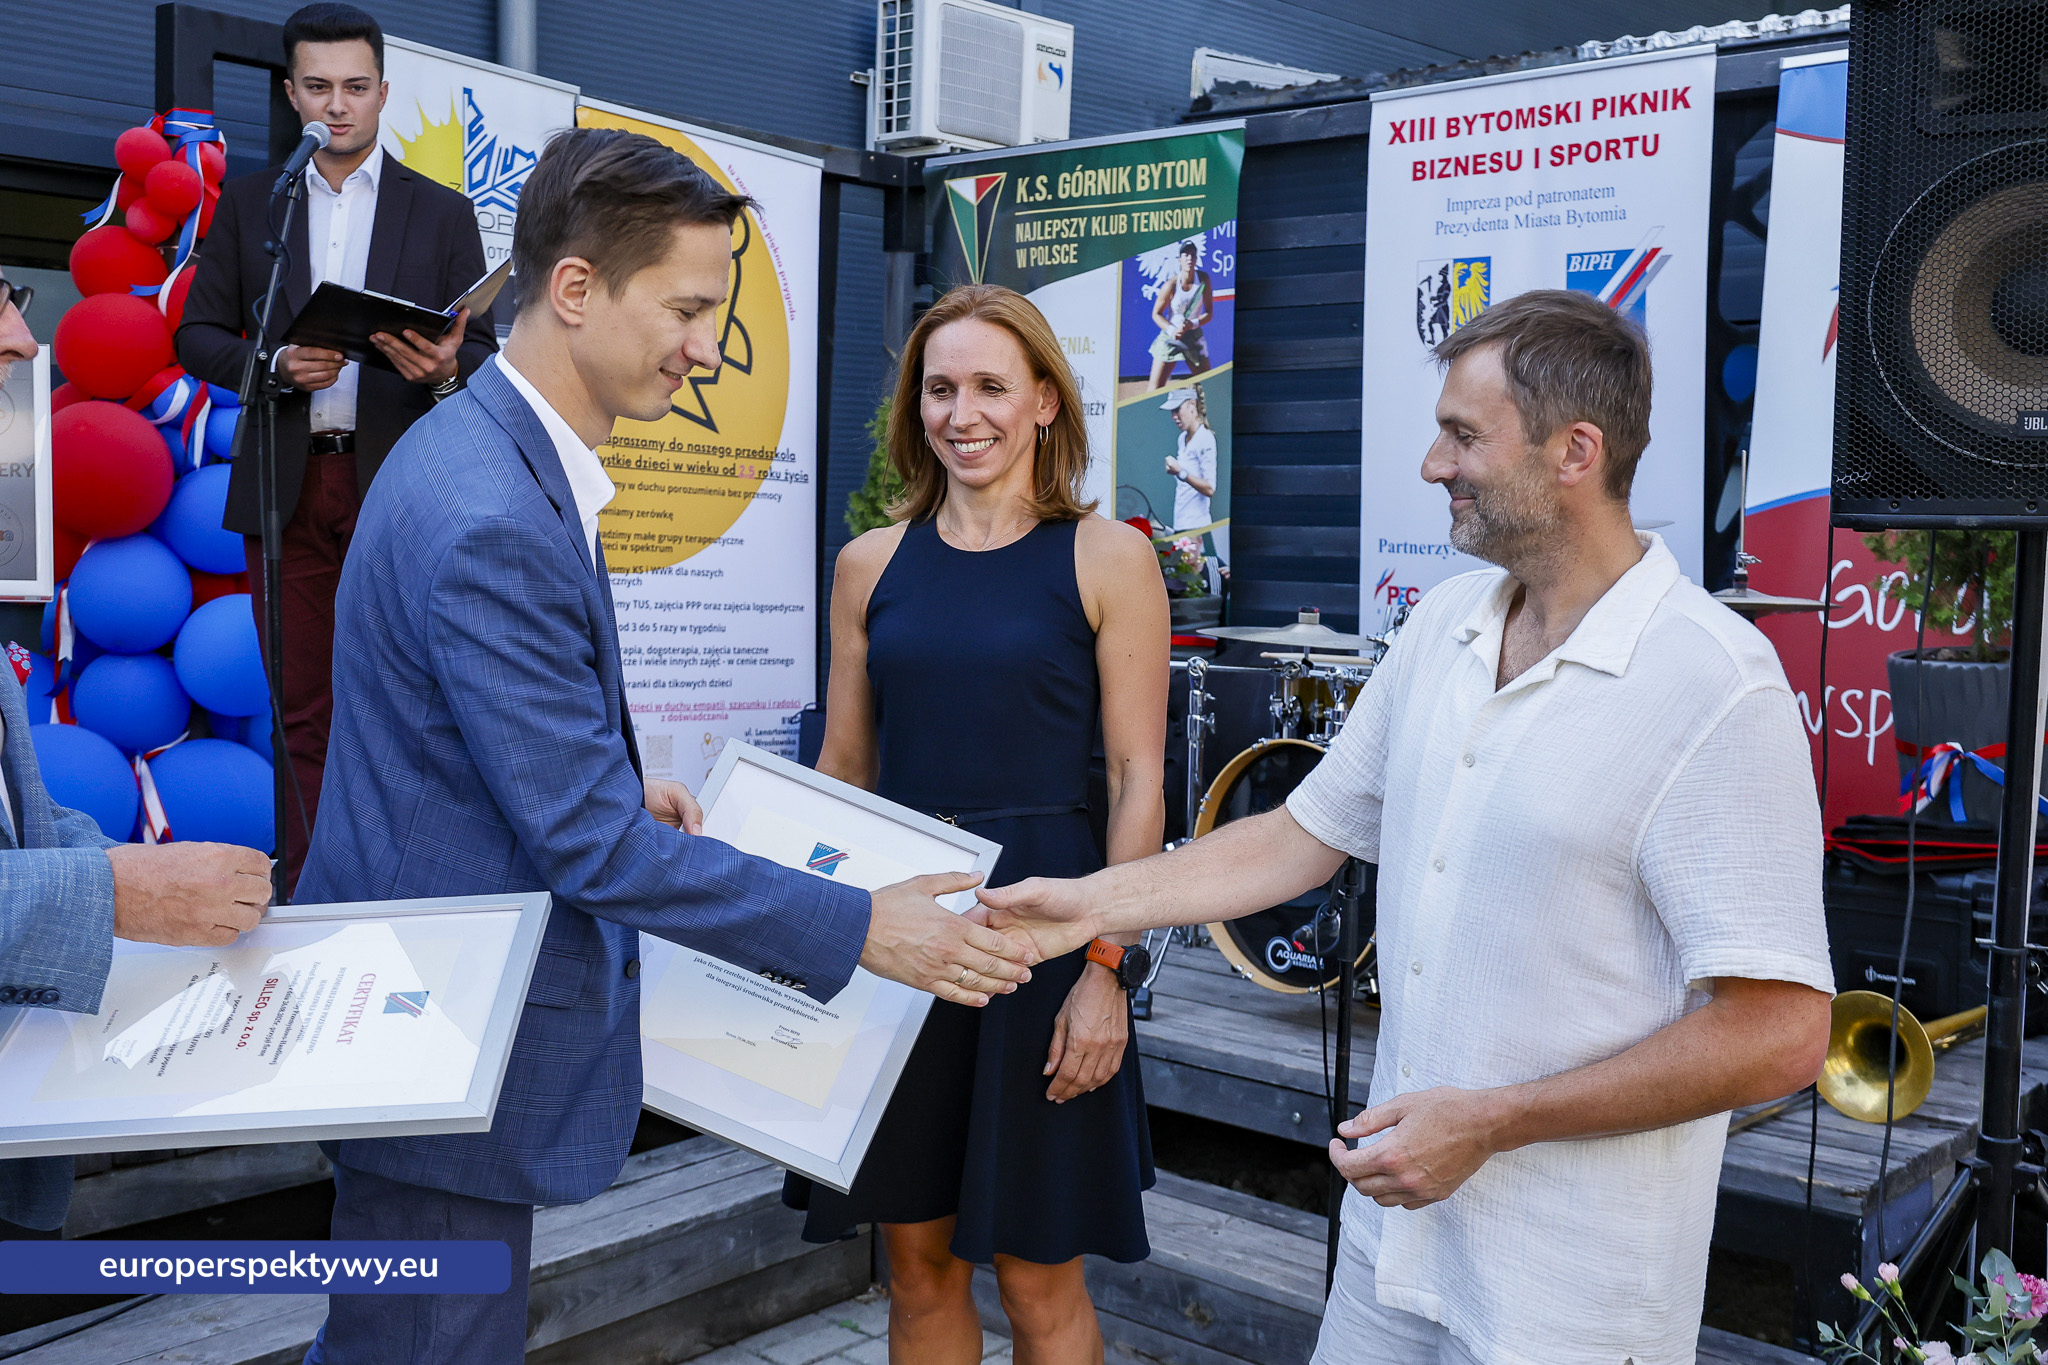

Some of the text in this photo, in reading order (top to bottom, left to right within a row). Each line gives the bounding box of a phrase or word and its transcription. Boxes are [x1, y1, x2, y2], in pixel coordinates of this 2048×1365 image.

[1388, 86, 1692, 145] XIII BYTOMSKI PIKNIK
[1412, 133, 1660, 182] BIZNESU I SPORTU
[1015, 157, 1208, 204] K.S. GÓRNIK BYTOM
[1447, 185, 1616, 215] Impreza pod patronatem
[1015, 206, 1205, 243] NAJLEPSZY KLUB TENISOWY
[1435, 205, 1627, 237] Prezydenta Miasta Bytomia
[1016, 243, 1079, 269] W POLSCE
[1211, 249, 1235, 277] Sp
[1568, 252, 1616, 272] BIPH
[765, 232, 783, 268] piękna
[778, 270, 797, 322] przygoda
[2024, 416, 2048, 430] JBL
[669, 437, 683, 451] do
[687, 443, 732, 459] naszego
[735, 445, 796, 462] przedszkola
[635, 455, 670, 471] dzieci
[674, 463, 683, 471] w
[686, 461, 719, 474] wieku
[722, 462, 736, 475] od
[758, 466, 781, 479] roku
[784, 469, 809, 484] życia
[637, 481, 665, 492] duchu
[667, 484, 726, 497] porozumienia
[728, 487, 741, 498] bez
[743, 490, 782, 503] przemocy
[636, 509, 674, 521] zerówkę
[620, 543, 628, 551] w
[630, 543, 673, 554] spektrum
[633, 531, 656, 540] małe
[658, 533, 683, 544] grupy
[685, 535, 745, 547] terapeutyczne
[633, 566, 644, 575] KS
[649, 566, 674, 576] WWR
[675, 566, 689, 577] dla
[690, 568, 724, 580] naszych
[1387, 585, 1420, 606] PEC
[654, 600, 684, 612] zajęcia
[685, 600, 702, 610] PPP
[703, 602, 722, 611] oraz
[723, 602, 751, 613] zajęcia
[752, 601, 805, 614] logopedyczne
[618, 622, 727, 635] od 3 do 5 razy w tygodniu
[644, 656, 667, 667] wiele
[669, 657, 698, 668] innych
[700, 657, 720, 668] zajęć
[736, 656, 757, 666] cenie
[759, 657, 795, 668] czesnego
[703, 645, 731, 657] zajęcia
[733, 646, 769, 655] taneczne
[652, 679, 667, 689] dla
[708, 678, 733, 688] dzieci
[664, 701, 691, 712] duchu
[255, 978, 279, 1009] SILLEO
[693, 956, 707, 965] jako
[707, 961, 724, 973] firmę
[723, 969, 746, 982] rzetelną
[749, 979, 783, 997] wiarygodną,
[784, 993, 815, 1010] wyrażającą
[814, 1006, 840, 1020] poparcie
[705, 972, 715, 980] dla
[715, 977, 743, 992] integracji
[742, 987, 774, 1004] środowiska
[247, 1010, 261, 1024] sp.
[337, 973, 376, 1044] CERTYFIKAT
[235, 1033, 250, 1050] o.o.
